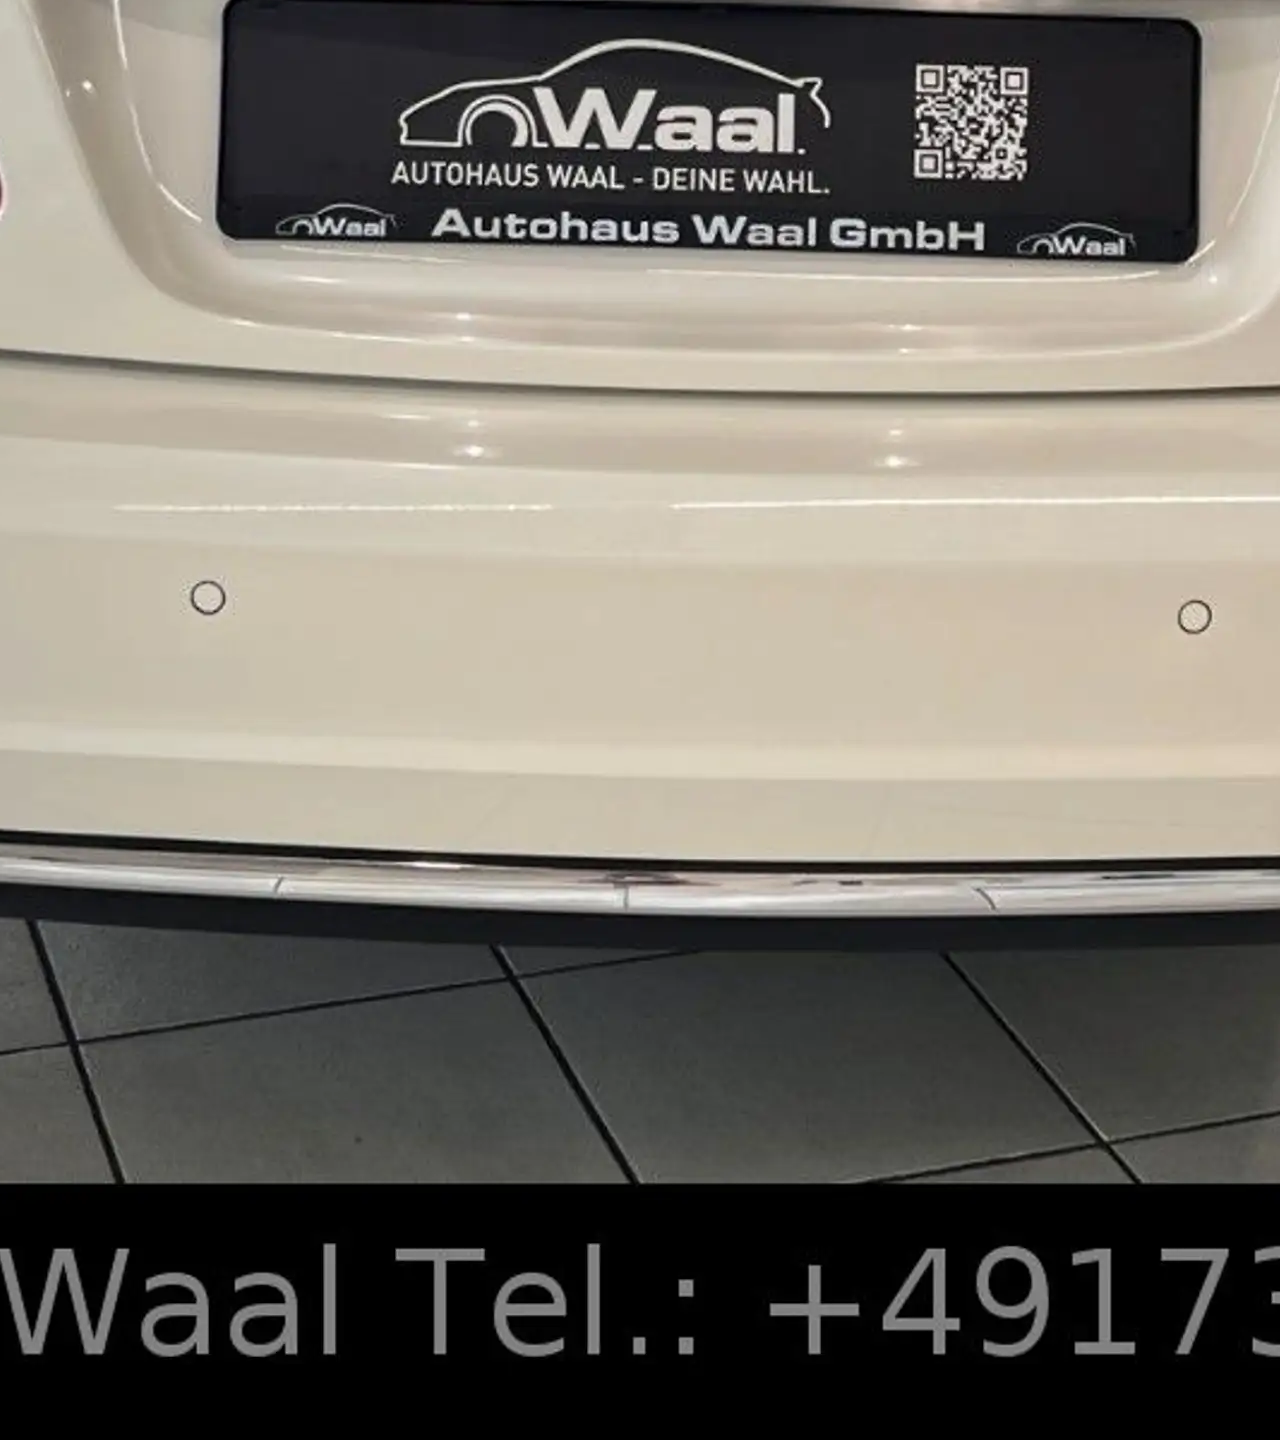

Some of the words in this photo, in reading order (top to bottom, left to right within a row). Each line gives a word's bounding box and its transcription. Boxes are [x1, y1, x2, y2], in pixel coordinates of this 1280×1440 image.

[391, 161, 538, 188] AUTOHAUS
[546, 164, 625, 190] WAAL
[652, 167, 735, 193] DEINE
[742, 168, 830, 195] WAHL.
[431, 207, 680, 245] Autohaus
[691, 213, 817, 248] Waal
[829, 218, 985, 252] GmbH
